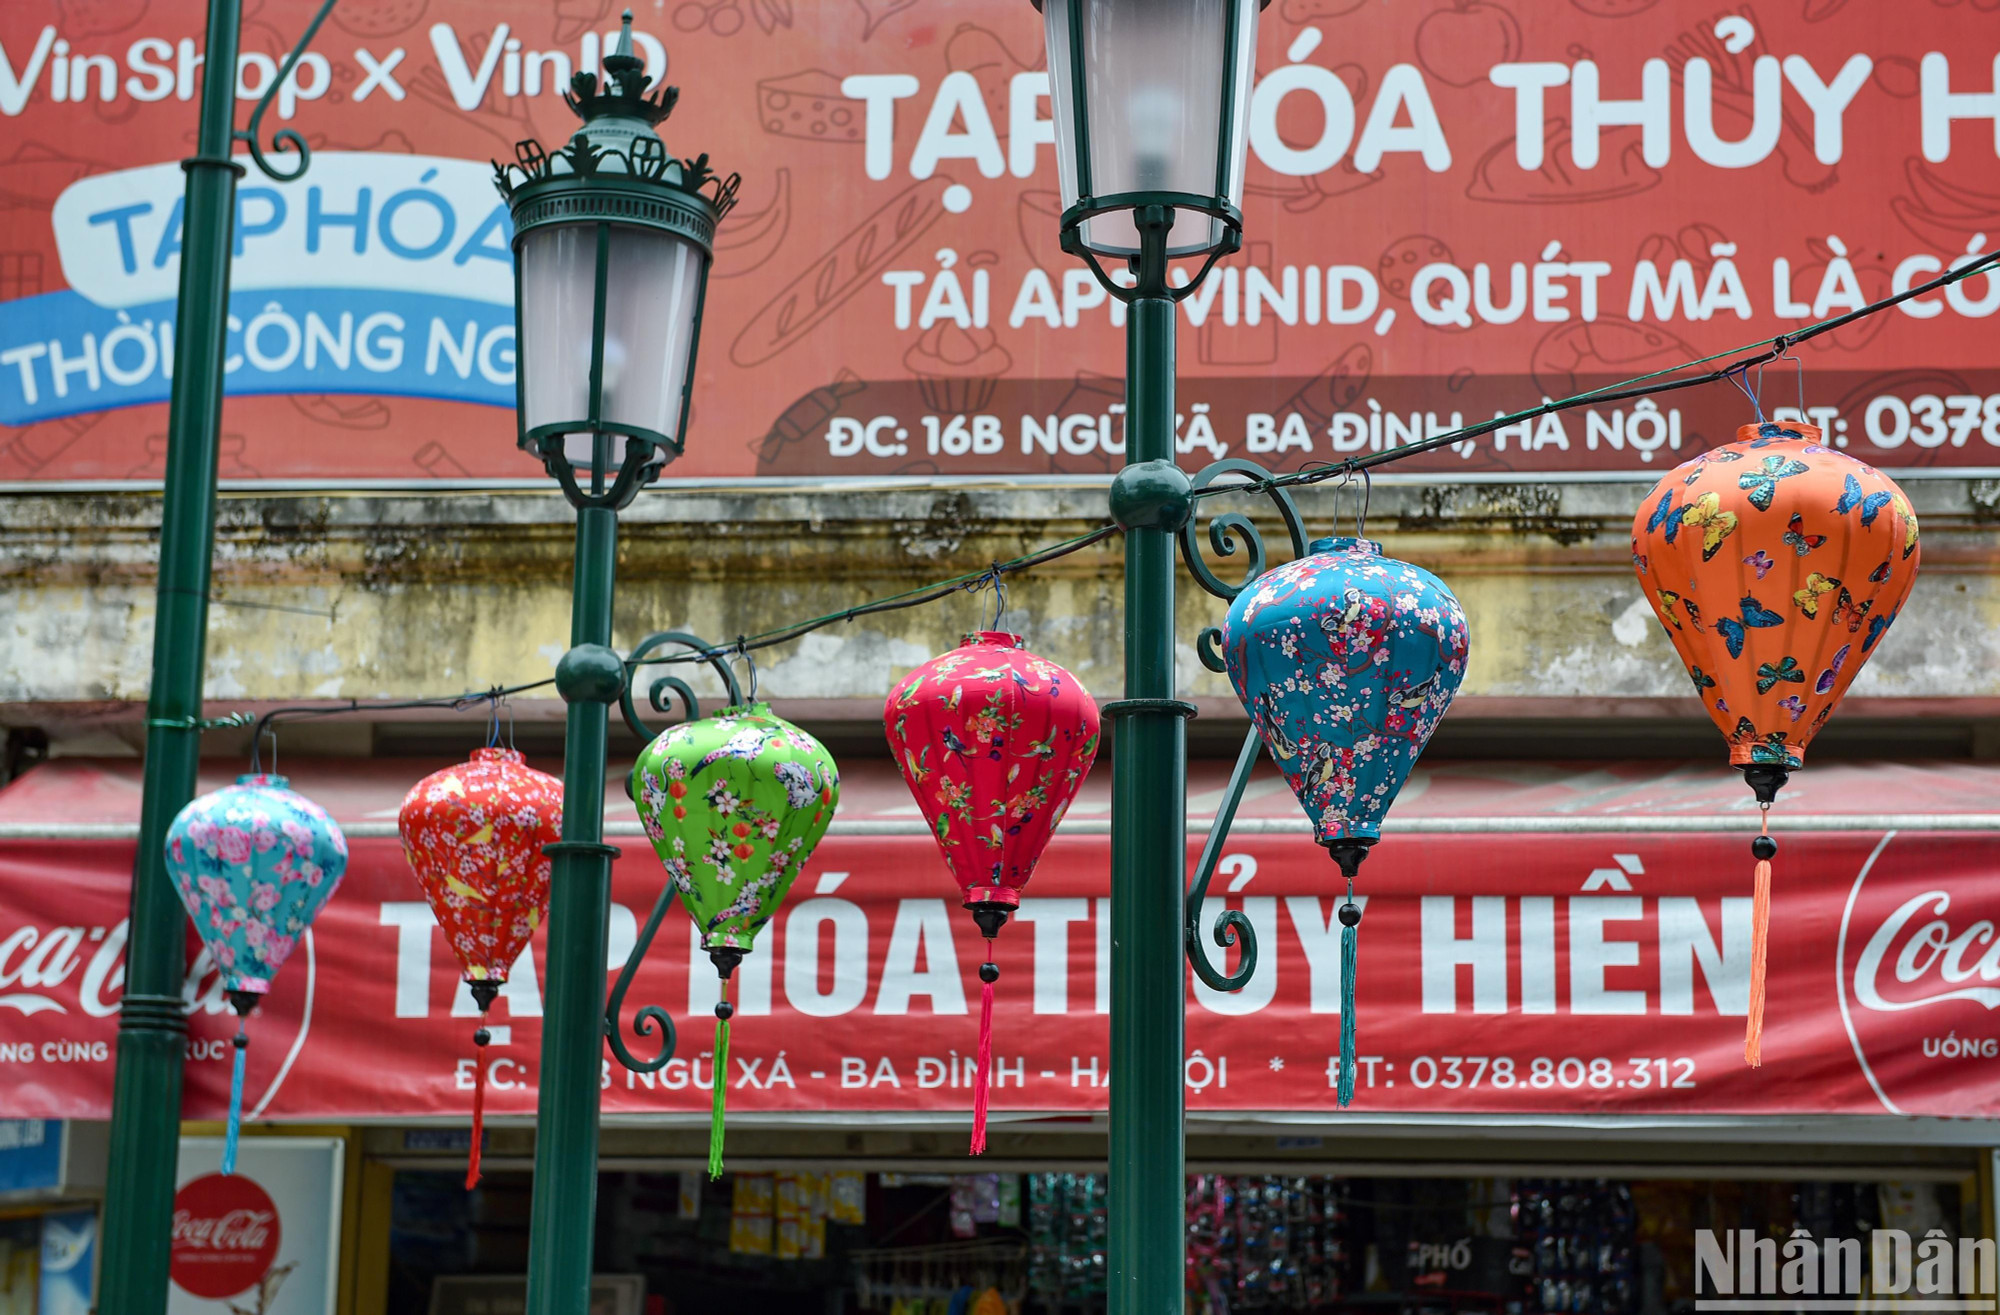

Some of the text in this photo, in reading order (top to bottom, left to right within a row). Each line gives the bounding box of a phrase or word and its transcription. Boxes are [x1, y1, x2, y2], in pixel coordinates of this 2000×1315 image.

[1249, 27, 1452, 176] ÓA
[1489, 15, 1873, 171] THỦY
[882, 248, 989, 330] TẢI
[1410, 240, 1612, 328] QUÉT
[1628, 242, 1752, 321] MÃ
[1773, 235, 1868, 319] LÀ
[0, 309, 174, 405] THỜI
[826, 416, 909, 457] ĐC:
[926, 415, 1004, 456] 16B
[1246, 412, 1314, 453] BA
[1586, 398, 1682, 462] NỘI
[1420, 854, 1753, 1017] HIỀN
[41, 1039, 108, 1063] CÙNG
[841, 1057, 900, 1089] BA
[915, 1050, 1024, 1088] ĐÌNH
[1184, 1049, 1227, 1094] ỘI
[1409, 1056, 1696, 1090] 0378.808.312
[1922, 1031, 1999, 1059] UỐNG
